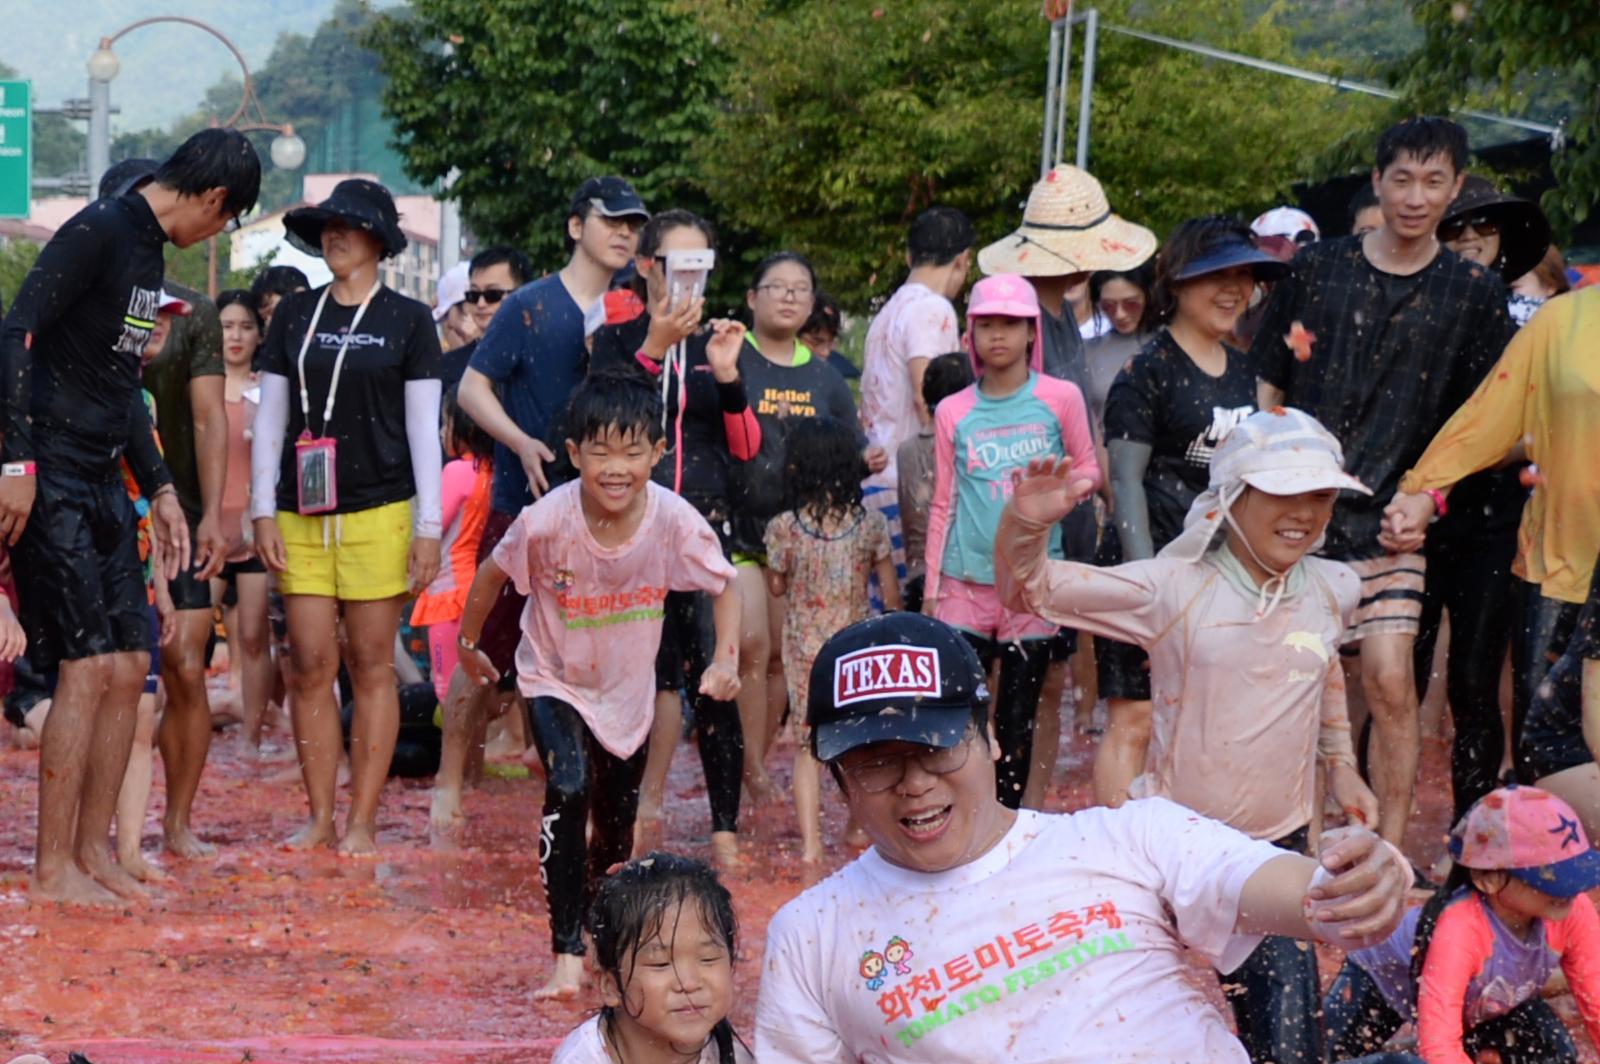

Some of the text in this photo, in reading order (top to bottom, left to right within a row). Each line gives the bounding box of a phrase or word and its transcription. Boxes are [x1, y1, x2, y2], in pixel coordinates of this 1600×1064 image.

[763, 388, 811, 403] Hello!
[976, 436, 1052, 468] Dream
[842, 653, 932, 696] TEXAS
[876, 900, 1122, 1024] 화천토마토축제
[896, 931, 1135, 1047] TOMATO FESTIVAL
